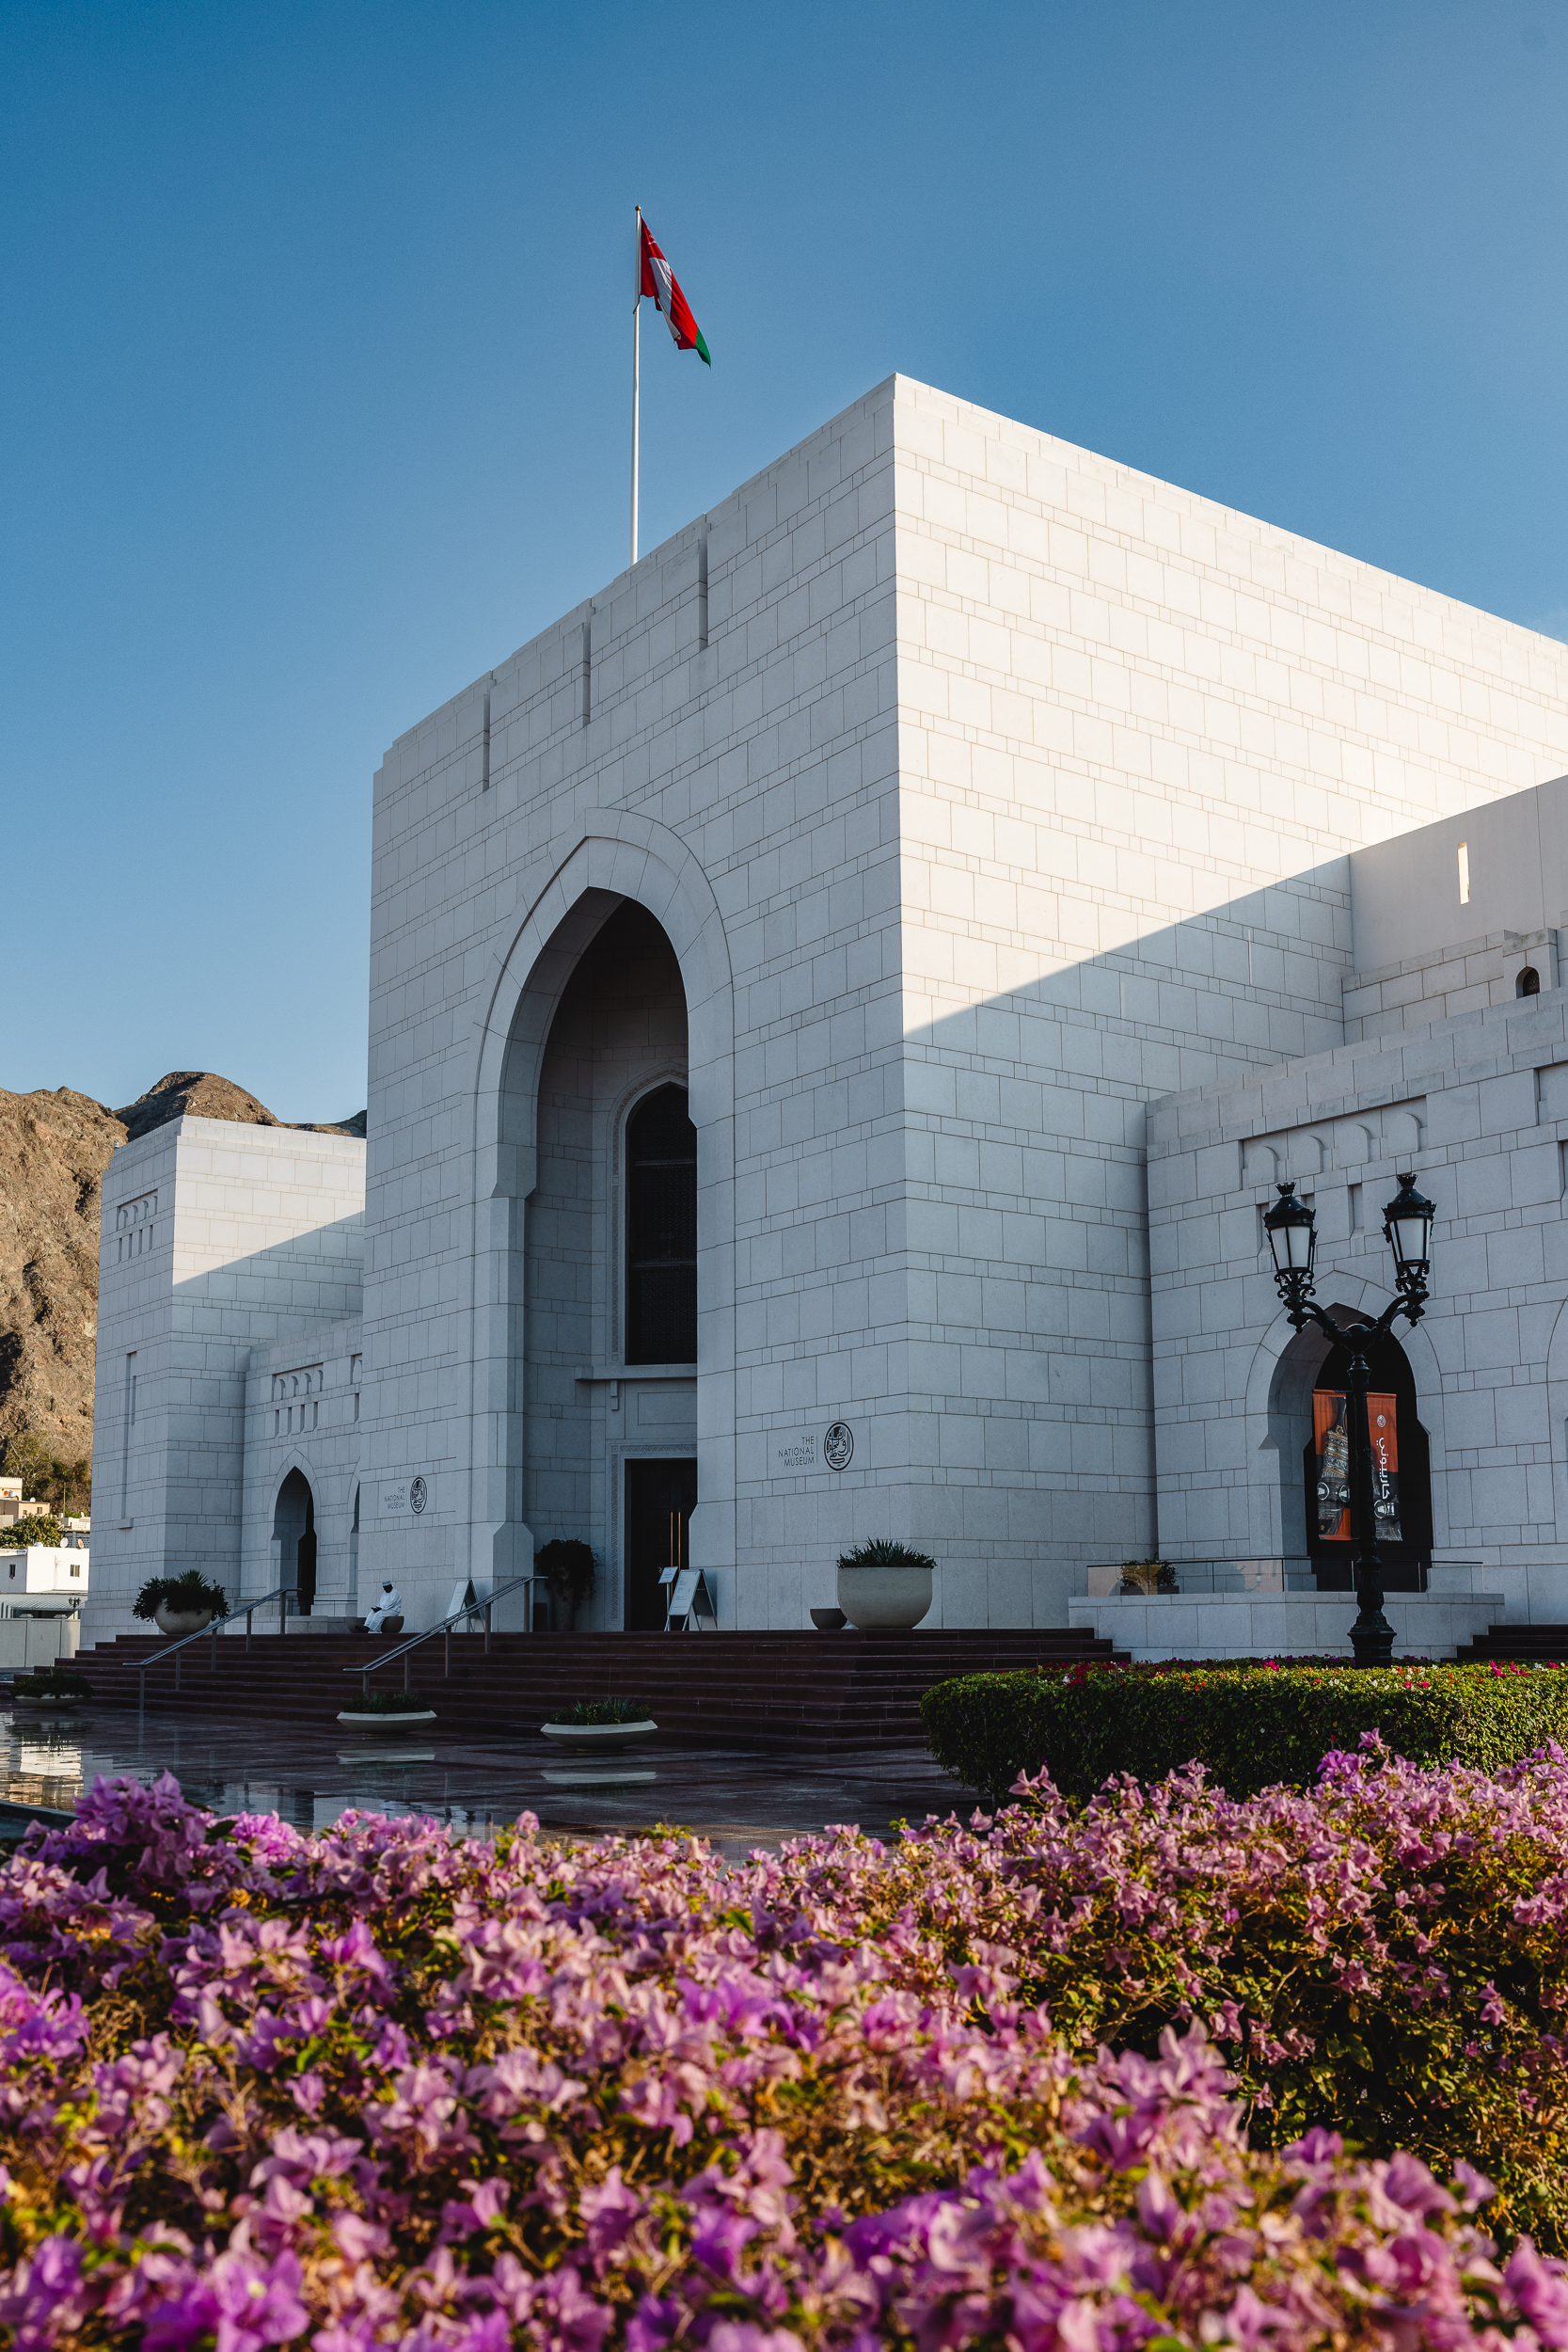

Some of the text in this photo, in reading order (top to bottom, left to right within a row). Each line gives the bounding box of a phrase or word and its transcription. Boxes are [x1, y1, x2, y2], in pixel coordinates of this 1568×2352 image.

[801, 1436, 815, 1446] THE
[778, 1446, 815, 1458] NATIONAL
[784, 1456, 815, 1467] MUSEUM
[397, 1486, 405, 1494] THE
[384, 1494, 405, 1502] NATIONAL
[387, 1502, 405, 1510] MUSEUM
